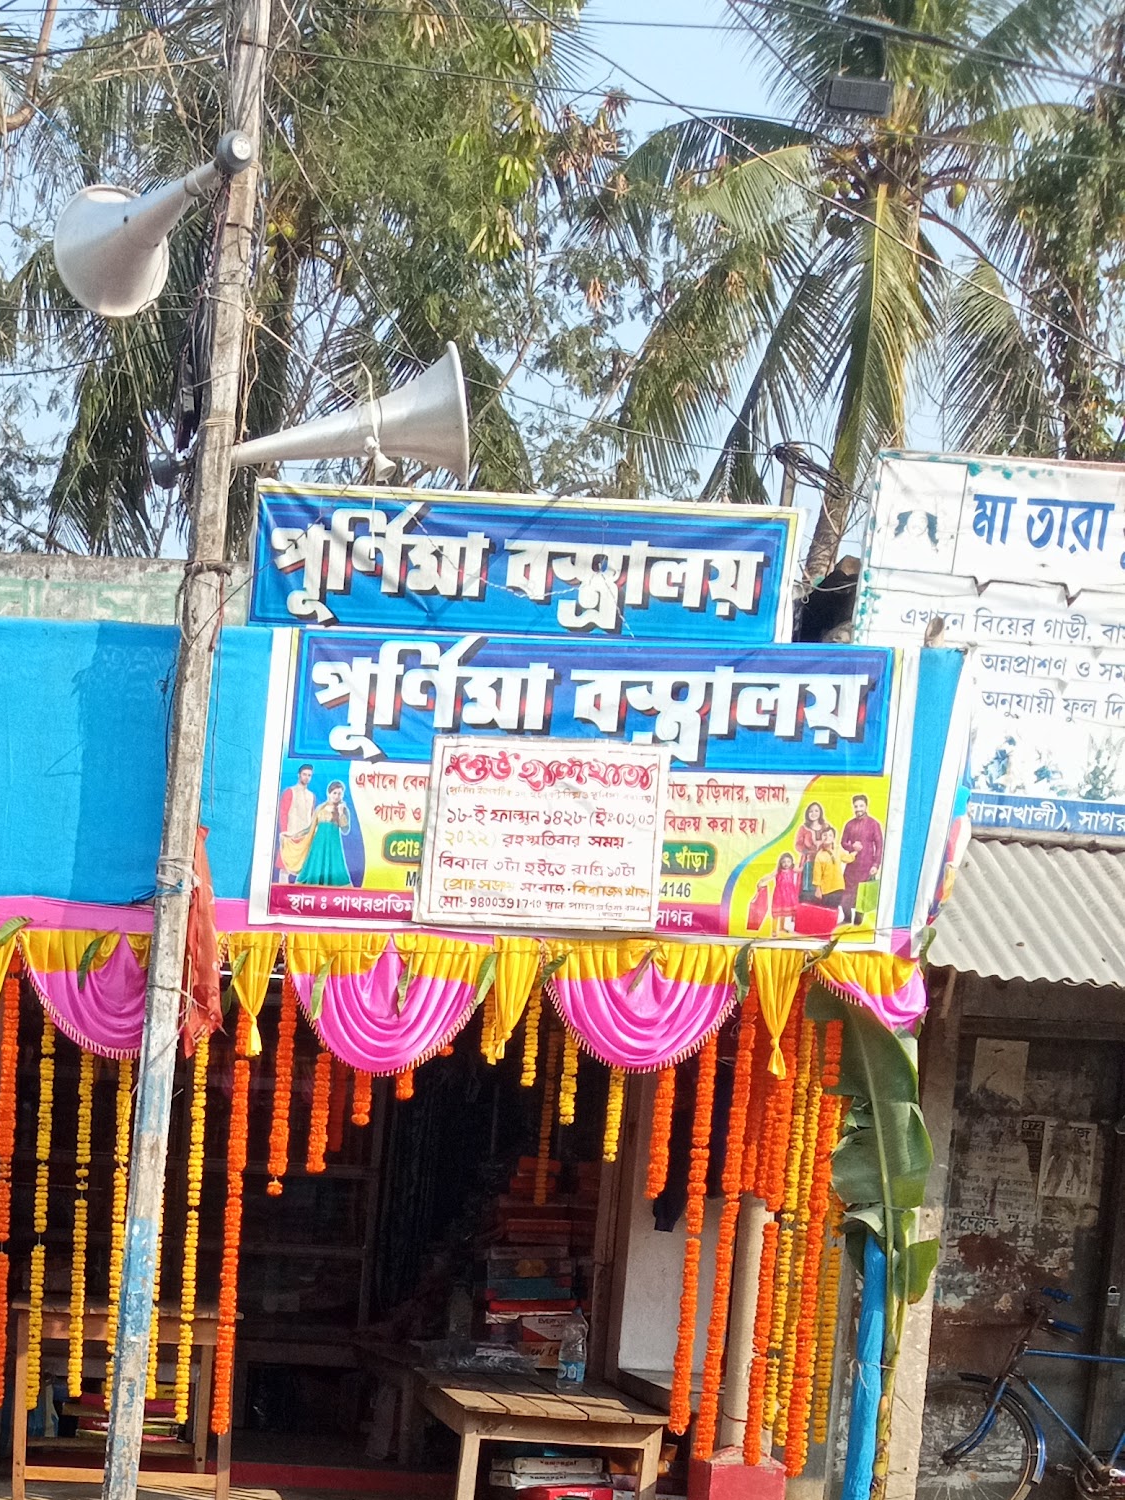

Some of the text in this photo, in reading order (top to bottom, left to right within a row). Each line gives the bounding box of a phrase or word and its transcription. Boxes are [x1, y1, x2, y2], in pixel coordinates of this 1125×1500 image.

[972, 494, 1115, 554] মা তারা
[271, 503, 491, 624] পূর্ণিমা
[974, 607, 1035, 637] বিয়ের
[1076, 661, 1091, 677] ও
[311, 636, 557, 758] পূর্ণিমা
[981, 688, 1056, 719] অনুযায়ী
[1062, 697, 1096, 723] ফুল
[355, 772, 398, 791] এখানে
[445, 750, 658, 792] শুভ হালখাতা
[696, 778, 751, 806] চুড়িদার,
[754, 784, 791, 804] জামা,
[374, 801, 423, 822] প্যান্ট ও
[664, 809, 702, 834] বিক্রয়
[706, 815, 734, 835] করা
[439, 850, 488, 871] বিকাল
[524, 858, 566, 877] হইতে
[675, 844, 710, 873] খাঁড়া
[287, 892, 316, 914] স্থান
[658, 882, 692, 898] 4146
